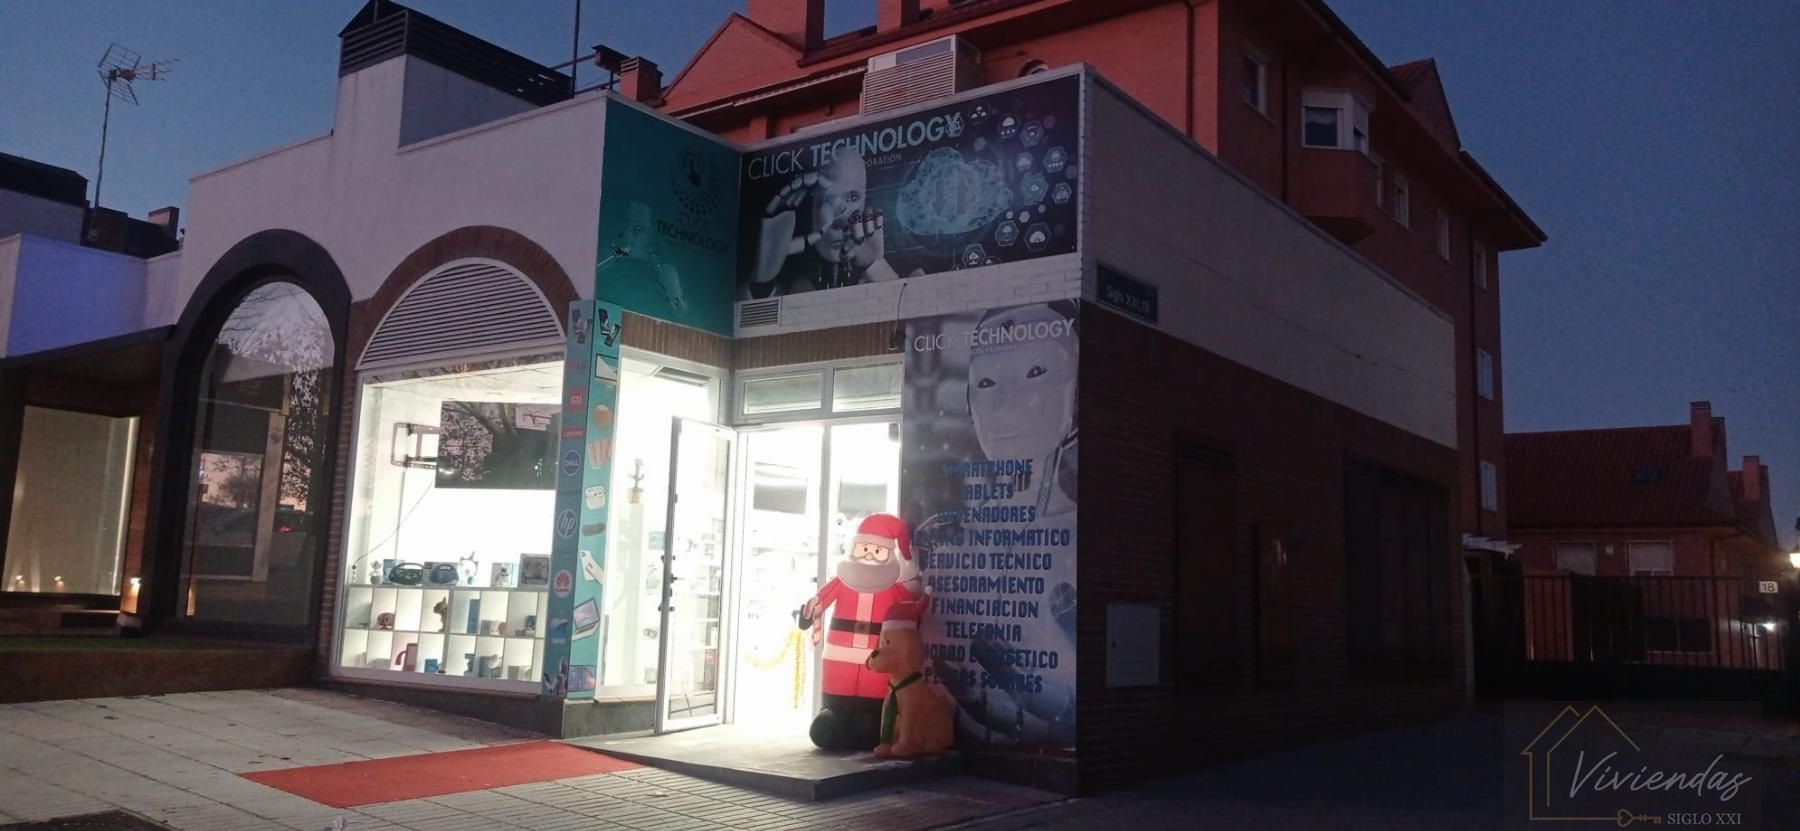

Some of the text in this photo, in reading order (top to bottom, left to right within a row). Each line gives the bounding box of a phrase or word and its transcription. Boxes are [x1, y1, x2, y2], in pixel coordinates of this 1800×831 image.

[748, 112, 962, 181] CLICK TECHNOLOGY
[963, 318, 1077, 347] TECHNOLOGY
[560, 512, 576, 538] hp
[944, 505, 1037, 524] ENADORES
[968, 528, 1071, 547] INFORMATICO
[989, 552, 1052, 571] TECNICO
[927, 575, 1045, 595] ASESORAMIENTO
[930, 597, 1039, 618] FINANCIACION
[945, 621, 1022, 642] TELEFONIA
[923, 643, 1059, 670] HORRO ERGETICO
